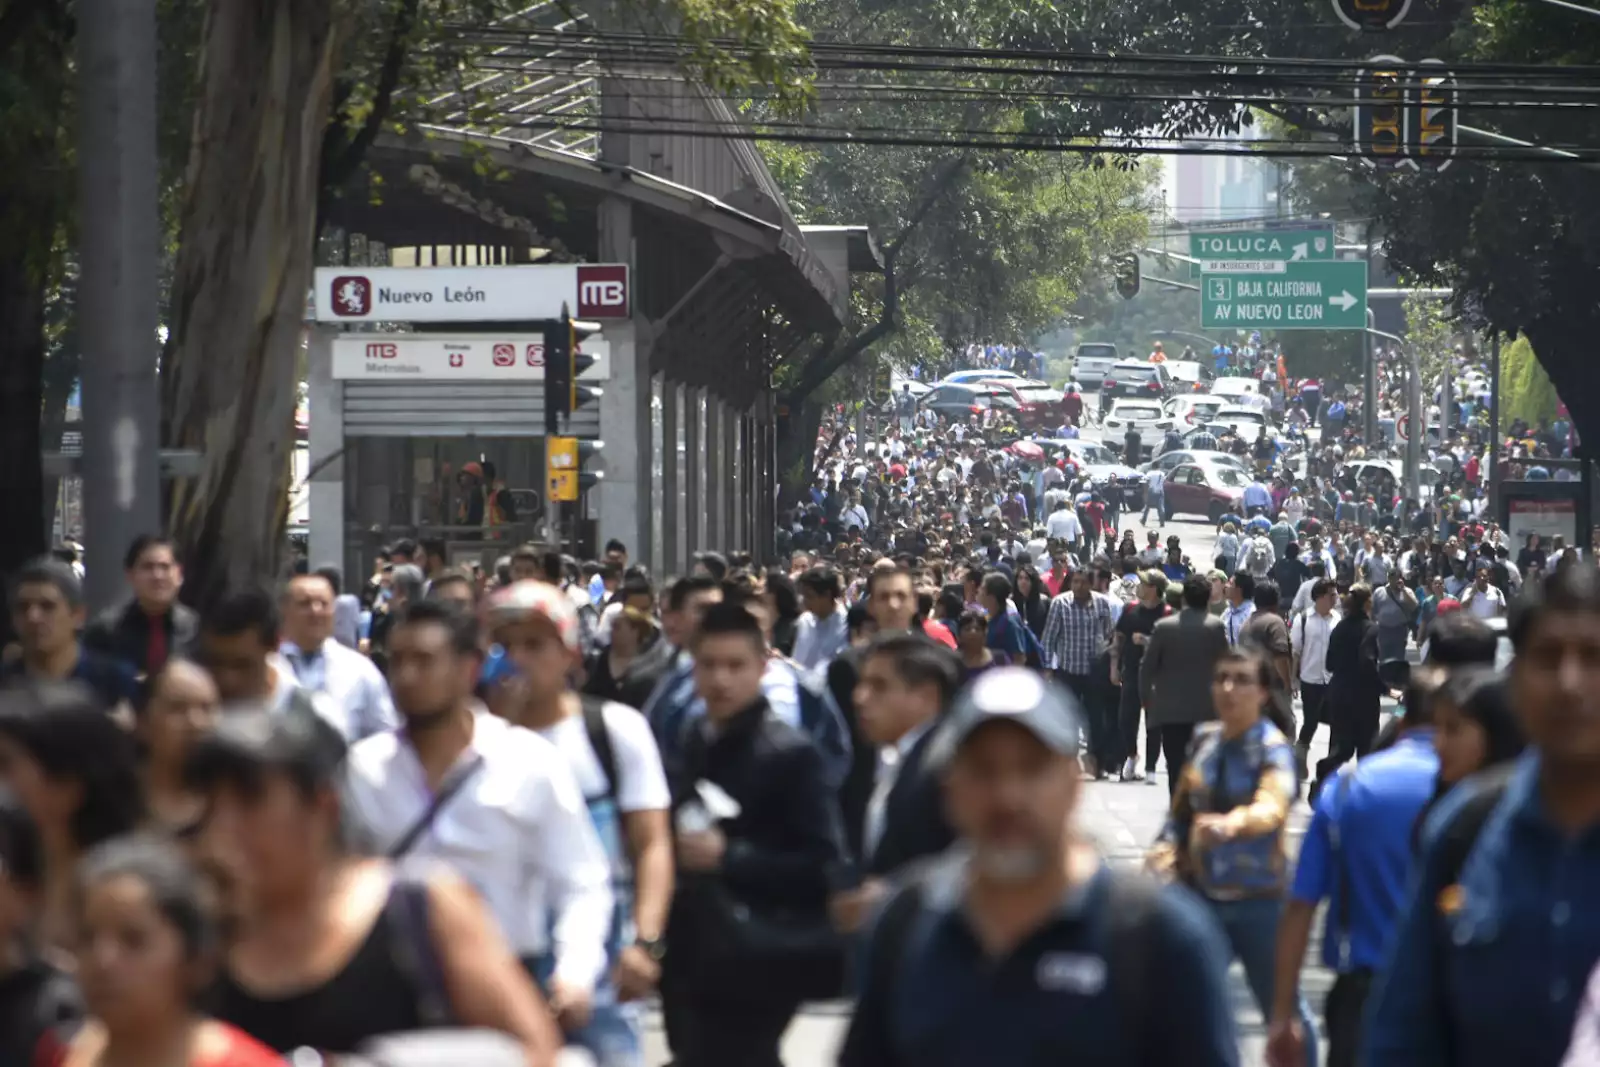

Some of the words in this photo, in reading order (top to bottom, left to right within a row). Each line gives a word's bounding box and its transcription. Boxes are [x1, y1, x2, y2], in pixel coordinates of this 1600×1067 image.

[1198, 238, 1282, 252] TOLUCA
[379, 288, 433, 303] Nuevo
[444, 286, 485, 303] León
[1215, 283, 1225, 296] 3
[1237, 282, 1263, 297] BAJA
[1267, 281, 1322, 297] CALIFORNIA
[1214, 304, 1232, 320] AV
[1237, 304, 1281, 320] NUEVO
[1288, 304, 1323, 320] LEON
